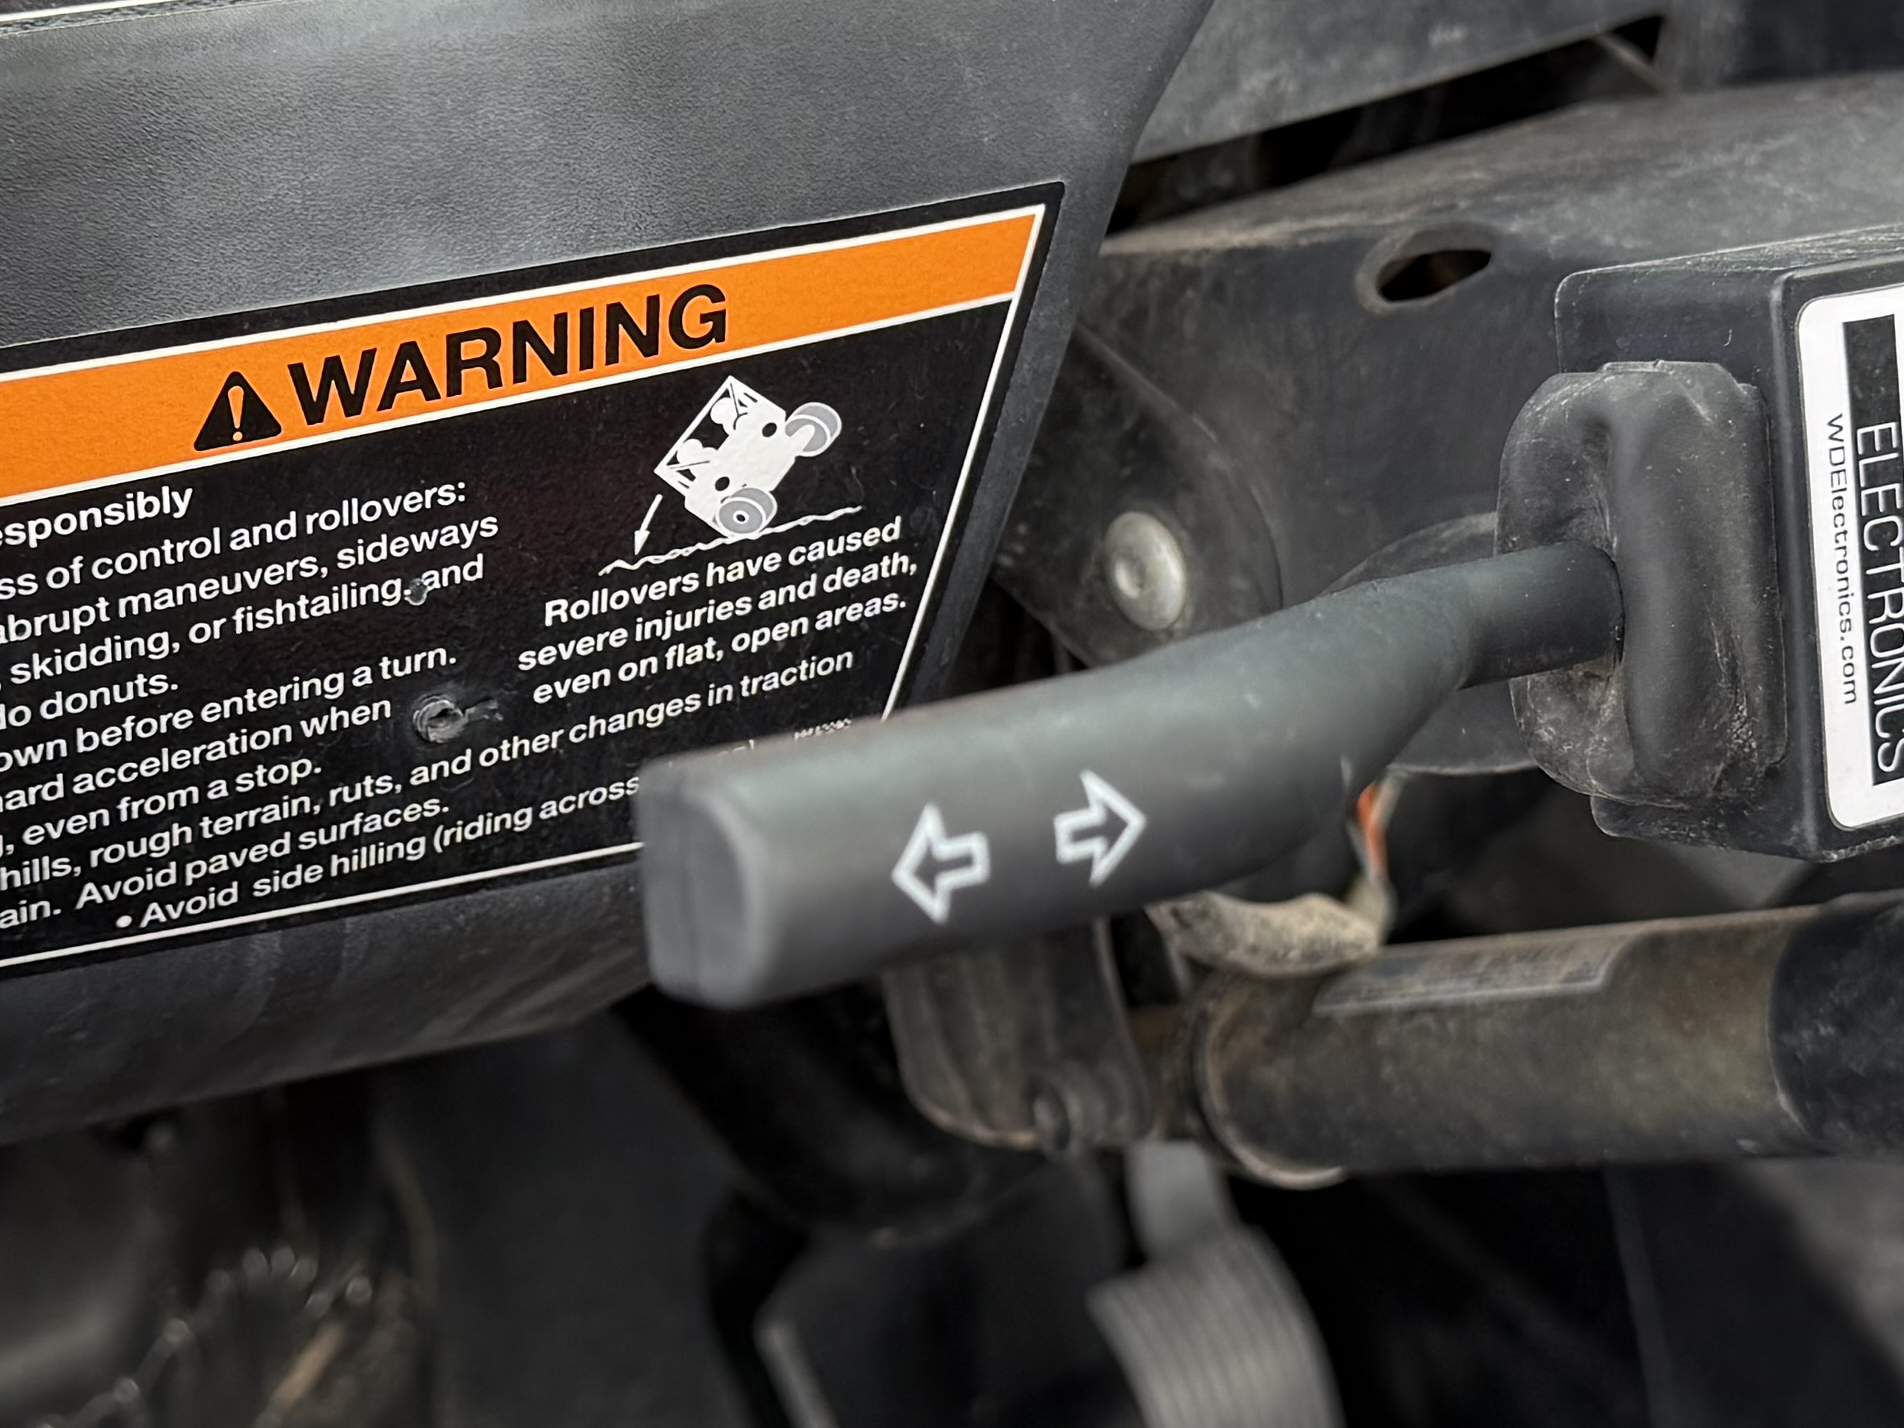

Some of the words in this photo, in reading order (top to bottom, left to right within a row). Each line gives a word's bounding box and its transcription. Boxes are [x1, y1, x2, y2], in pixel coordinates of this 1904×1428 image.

[289, 283, 728, 424] WARNING
[46, 555, 84, 589] of
[91, 527, 221, 579] control
[229, 511, 297, 550] and
[306, 482, 465, 534] rollovers:
[119, 556, 328, 617] maneuvers,
[337, 516, 499, 569] sideways
[545, 573, 699, 626] Rollovers
[706, 552, 782, 587] have
[788, 516, 901, 565] caused
[1826, 413, 1858, 706] WDElectronics.com
[10, 631, 181, 684] skidding,
[188, 616, 227, 644] or
[422, 552, 484, 591] and
[518, 628, 628, 670] severe
[635, 596, 752, 641] injuries
[758, 573, 818, 610] and
[823, 552, 917, 593] death,
[533, 668, 611, 703] even
[617, 656, 659, 682] on
[665, 637, 723, 670] flat,
[731, 617, 809, 653] open
[815, 593, 906, 630] areas.
[39, 674, 178, 719] donuts.
[73, 725, 292, 794] acceleration
[300, 700, 391, 737] when
[76, 709, 194, 752] before
[201, 672, 345, 722] entering
[352, 665, 373, 687] a
[379, 647, 456, 679] turn.
[0, 856, 81, 890] hills,
[90, 823, 192, 867] rough
[199, 795, 321, 838] terrain,
[329, 775, 402, 806] ruts,
[409, 748, 472, 786] and
[479, 729, 565, 767] other
[568, 693, 701, 743] changes
[707, 683, 734, 707] in
[740, 651, 853, 697] traction
[22, 808, 110, 845] even
[117, 786, 199, 822] from
[207, 779, 229, 800] a
[235, 758, 322, 792] stop.
[76, 861, 177, 909] Avoid
[185, 831, 291, 886] paved
[298, 798, 449, 850] surfaces.
[140, 881, 238, 927] Avoid
[253, 864, 324, 897] side
[330, 836, 426, 876] hilling
[433, 807, 533, 853] (riding
[539, 775, 642, 819] across
